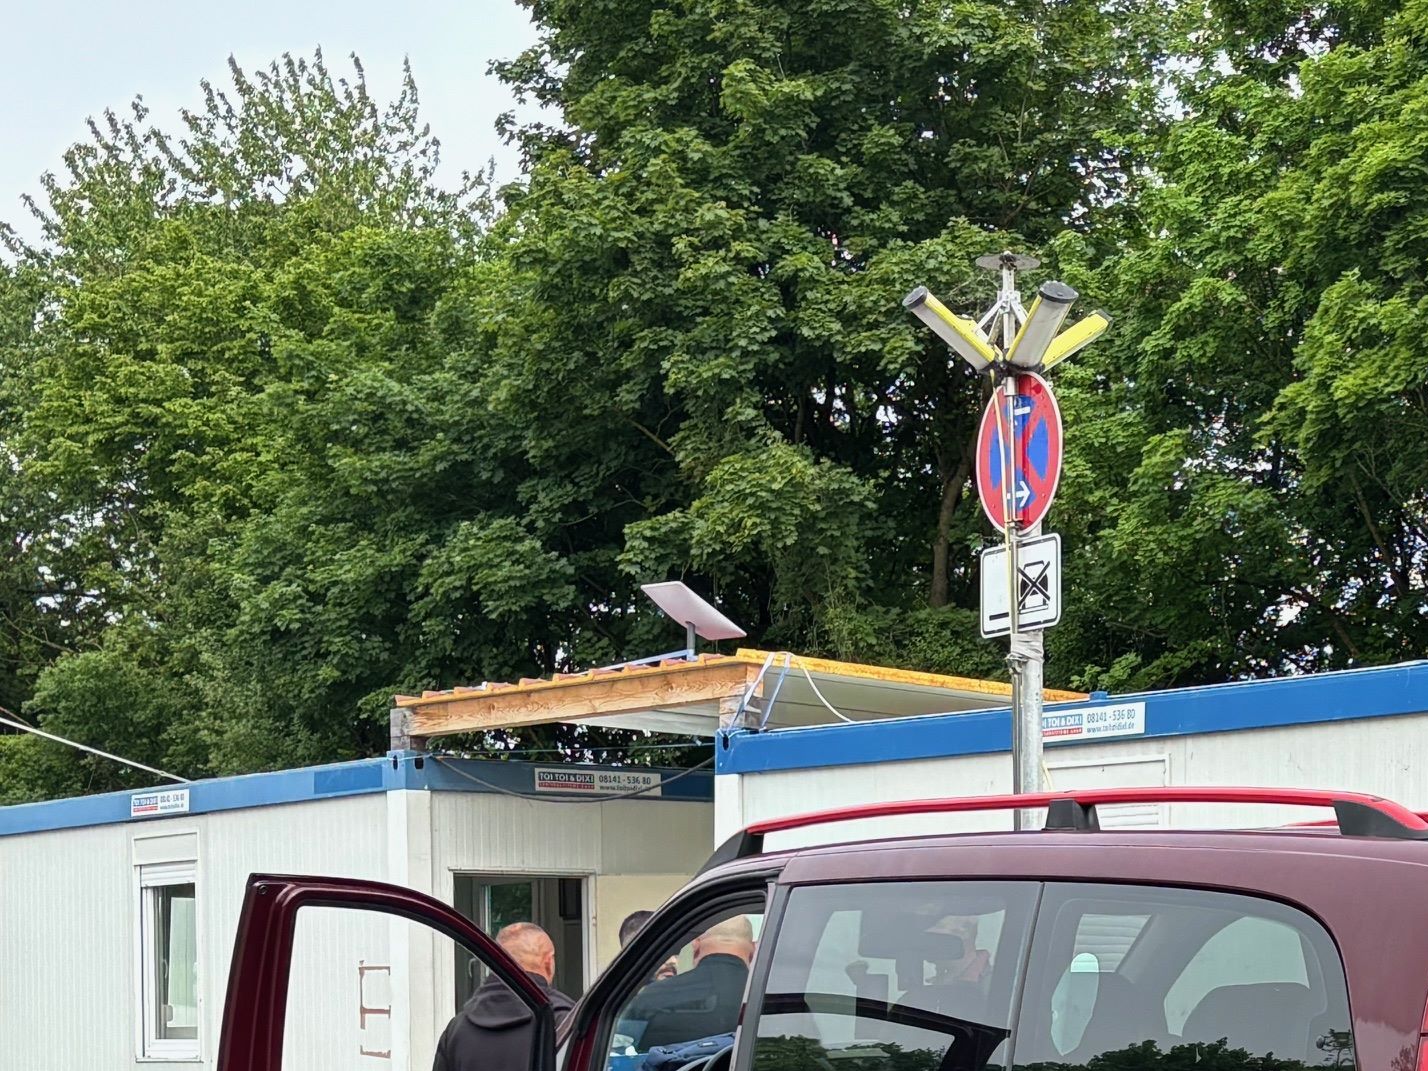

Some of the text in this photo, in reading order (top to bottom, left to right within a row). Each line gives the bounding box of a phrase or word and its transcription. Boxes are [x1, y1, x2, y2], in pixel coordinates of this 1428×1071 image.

[1048, 715, 1060, 727] TOI
[1067, 713, 1083, 726] DIXI
[540, 772, 553, 781] TOI
[555, 773, 569, 782] TOI
[576, 774, 594, 784] DIXI
[599, 774, 621, 784] 08141
[627, 776, 641, 785] 536
